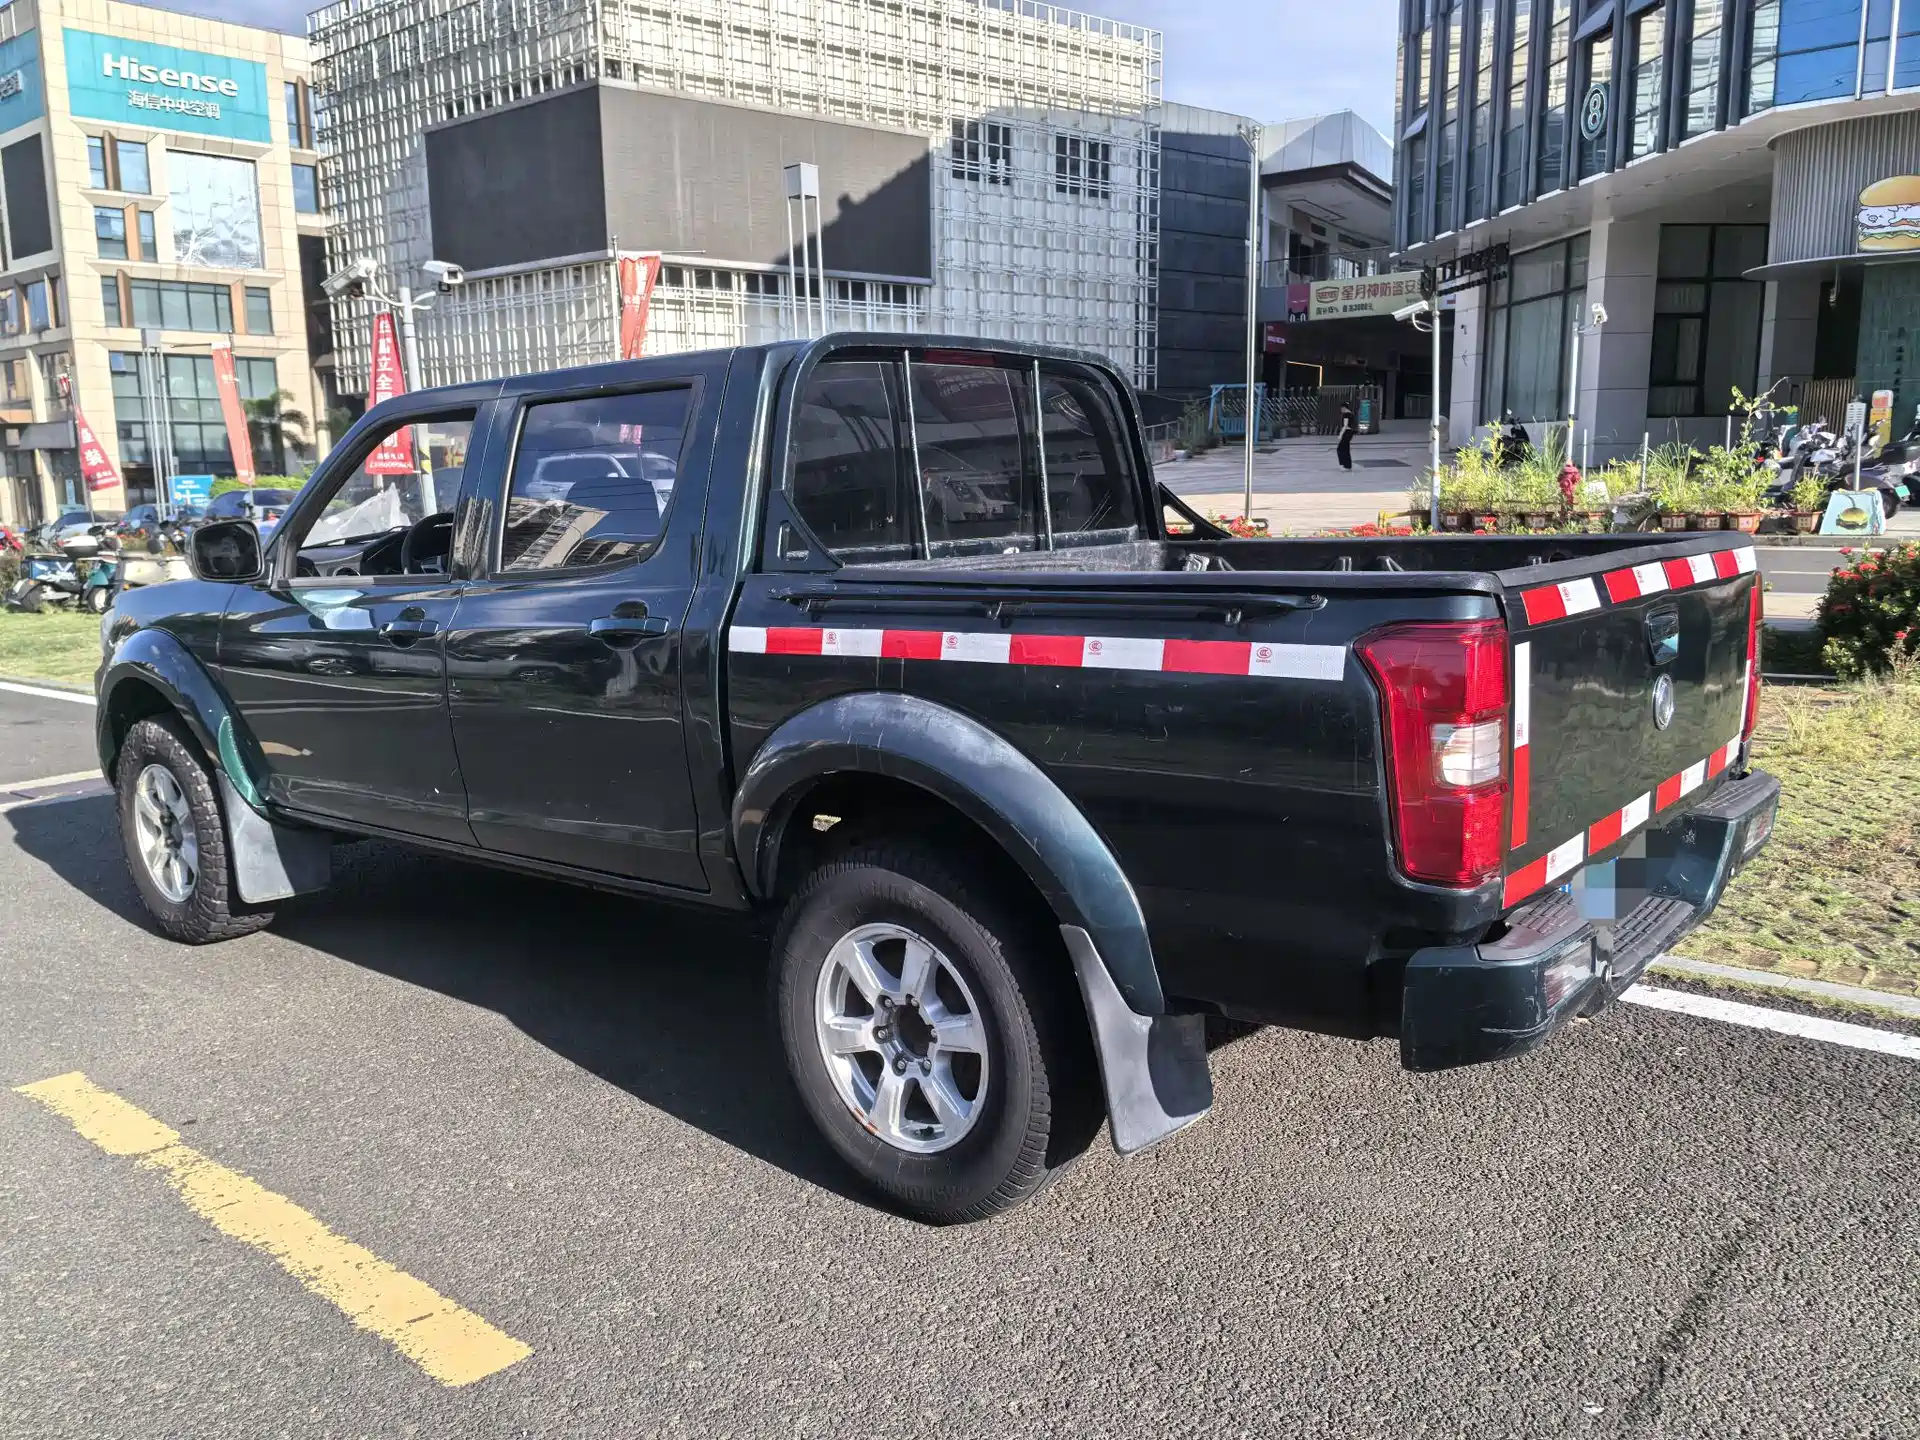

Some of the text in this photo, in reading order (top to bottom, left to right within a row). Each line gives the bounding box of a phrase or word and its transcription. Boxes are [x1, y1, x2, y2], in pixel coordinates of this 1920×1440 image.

[103, 53, 238, 97] Hisense
[128, 89, 220, 120] 海信中央空调
